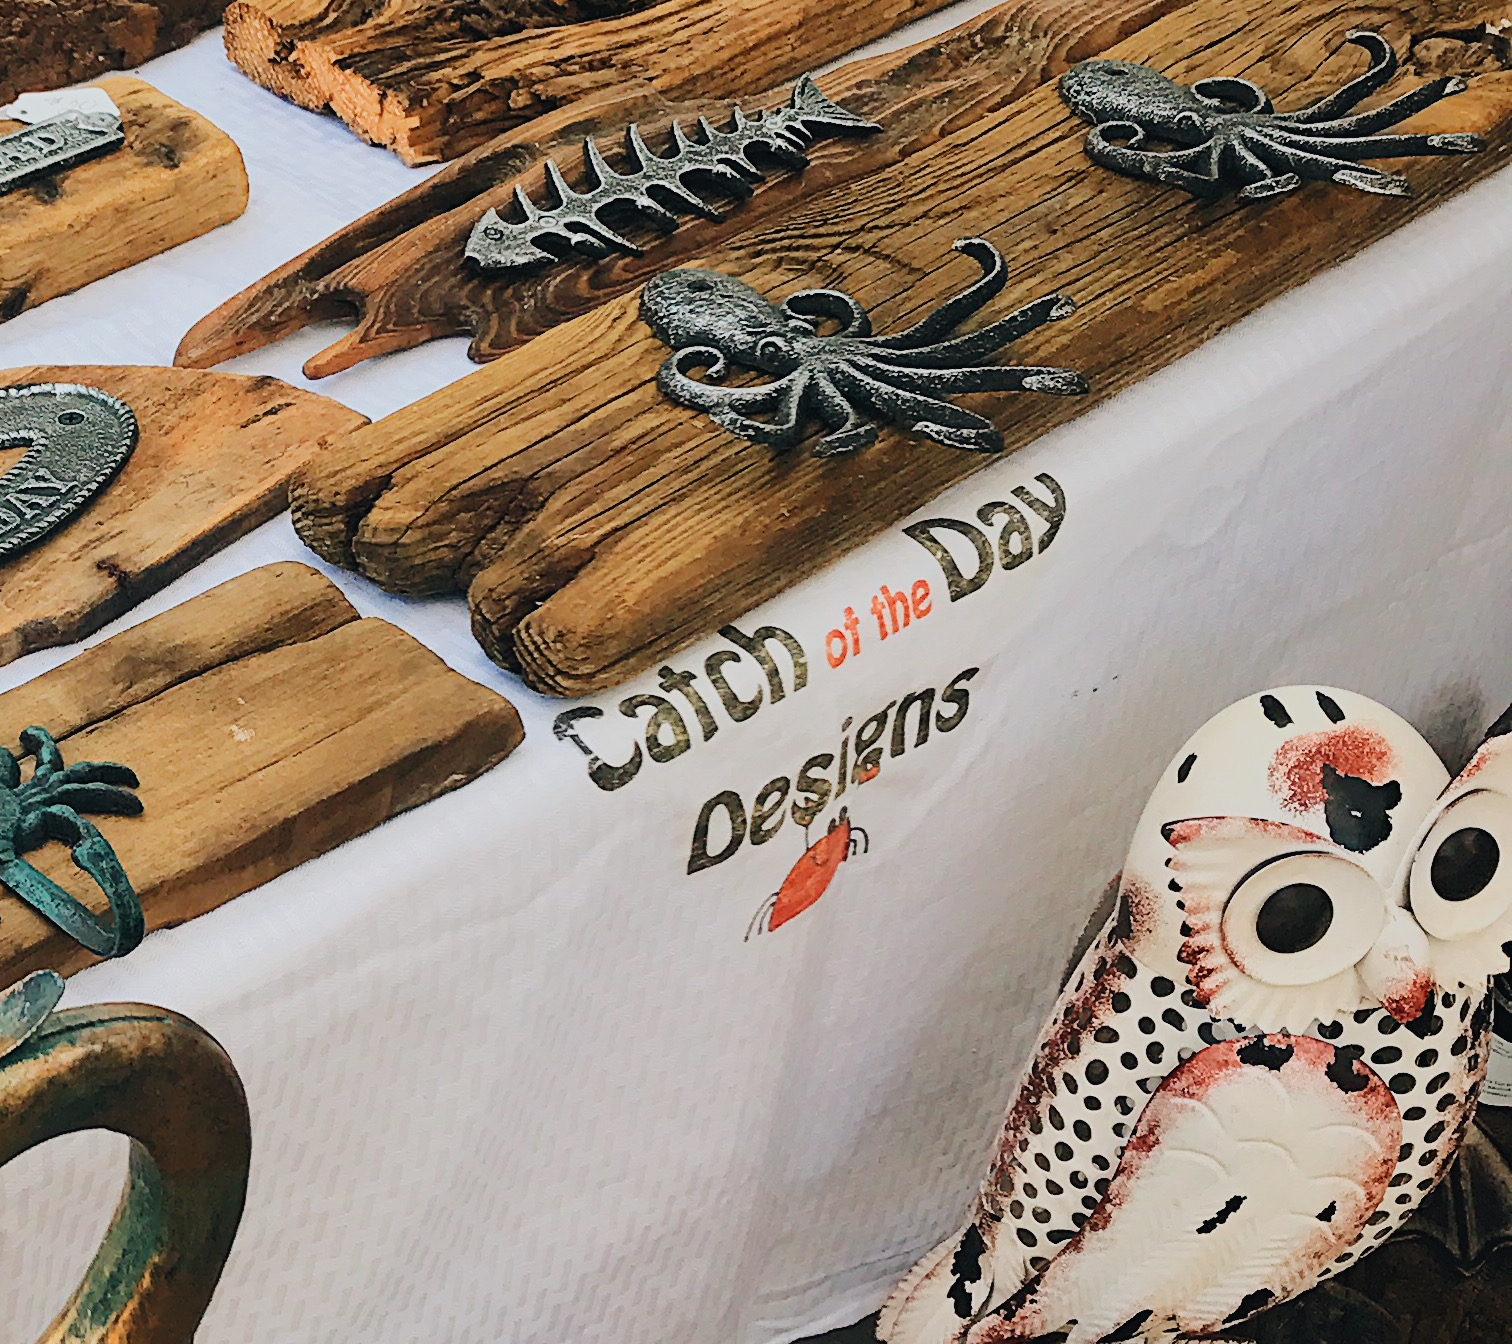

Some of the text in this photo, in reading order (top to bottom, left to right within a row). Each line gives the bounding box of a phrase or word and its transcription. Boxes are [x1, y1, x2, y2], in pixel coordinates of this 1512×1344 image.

[551, 471, 1067, 792] Catch of the Day
[686, 666, 981, 876] Designs
